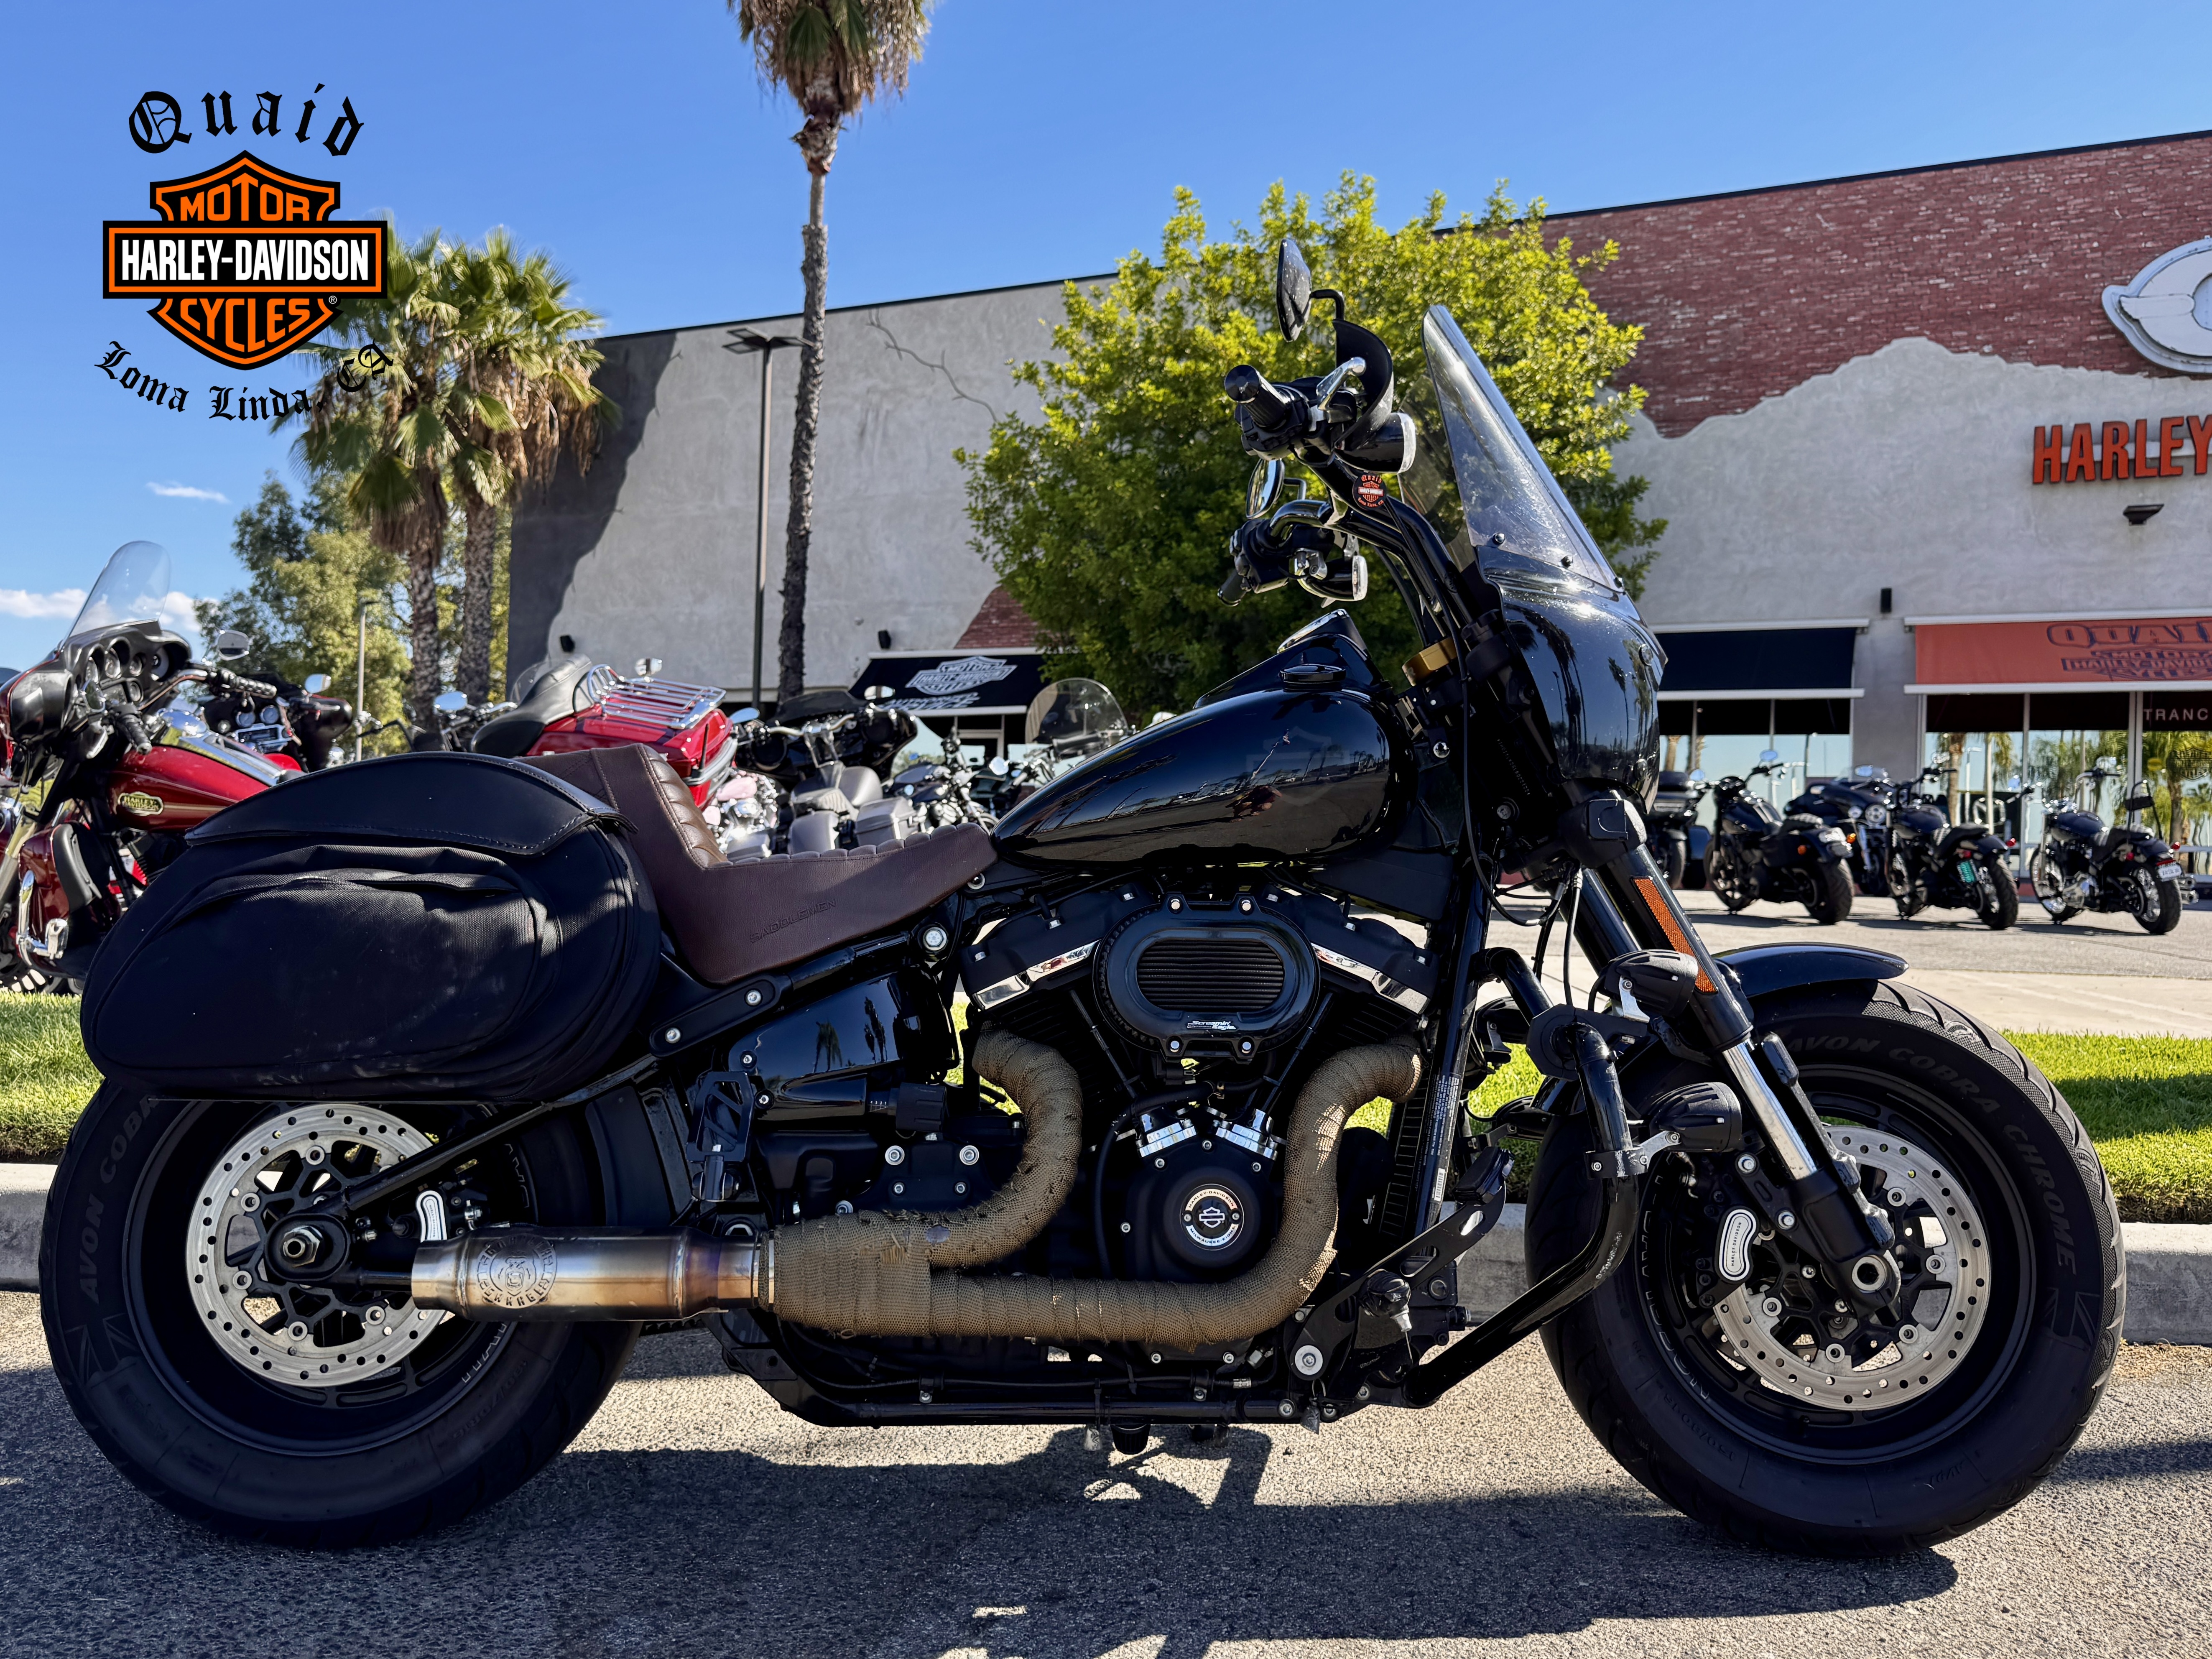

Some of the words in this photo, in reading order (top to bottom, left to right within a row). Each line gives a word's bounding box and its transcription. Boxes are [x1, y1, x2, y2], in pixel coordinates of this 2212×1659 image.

[2032, 414, 2212, 485] HARLEY
[2047, 622, 2212, 648] QUAI
[2143, 708, 2212, 721] TRANC
[750, 898, 836, 944] SADDLEMEN
[1786, 1035, 1881, 1053] AVON
[1888, 1046, 2001, 1114] COBRA
[2002, 1124, 2077, 1276] CHROME
[79, 1192, 105, 1304] AVON
[100, 1094, 161, 1184] COBR
[1189, 1191, 1234, 1208] HARLEY-DAVIDSON
